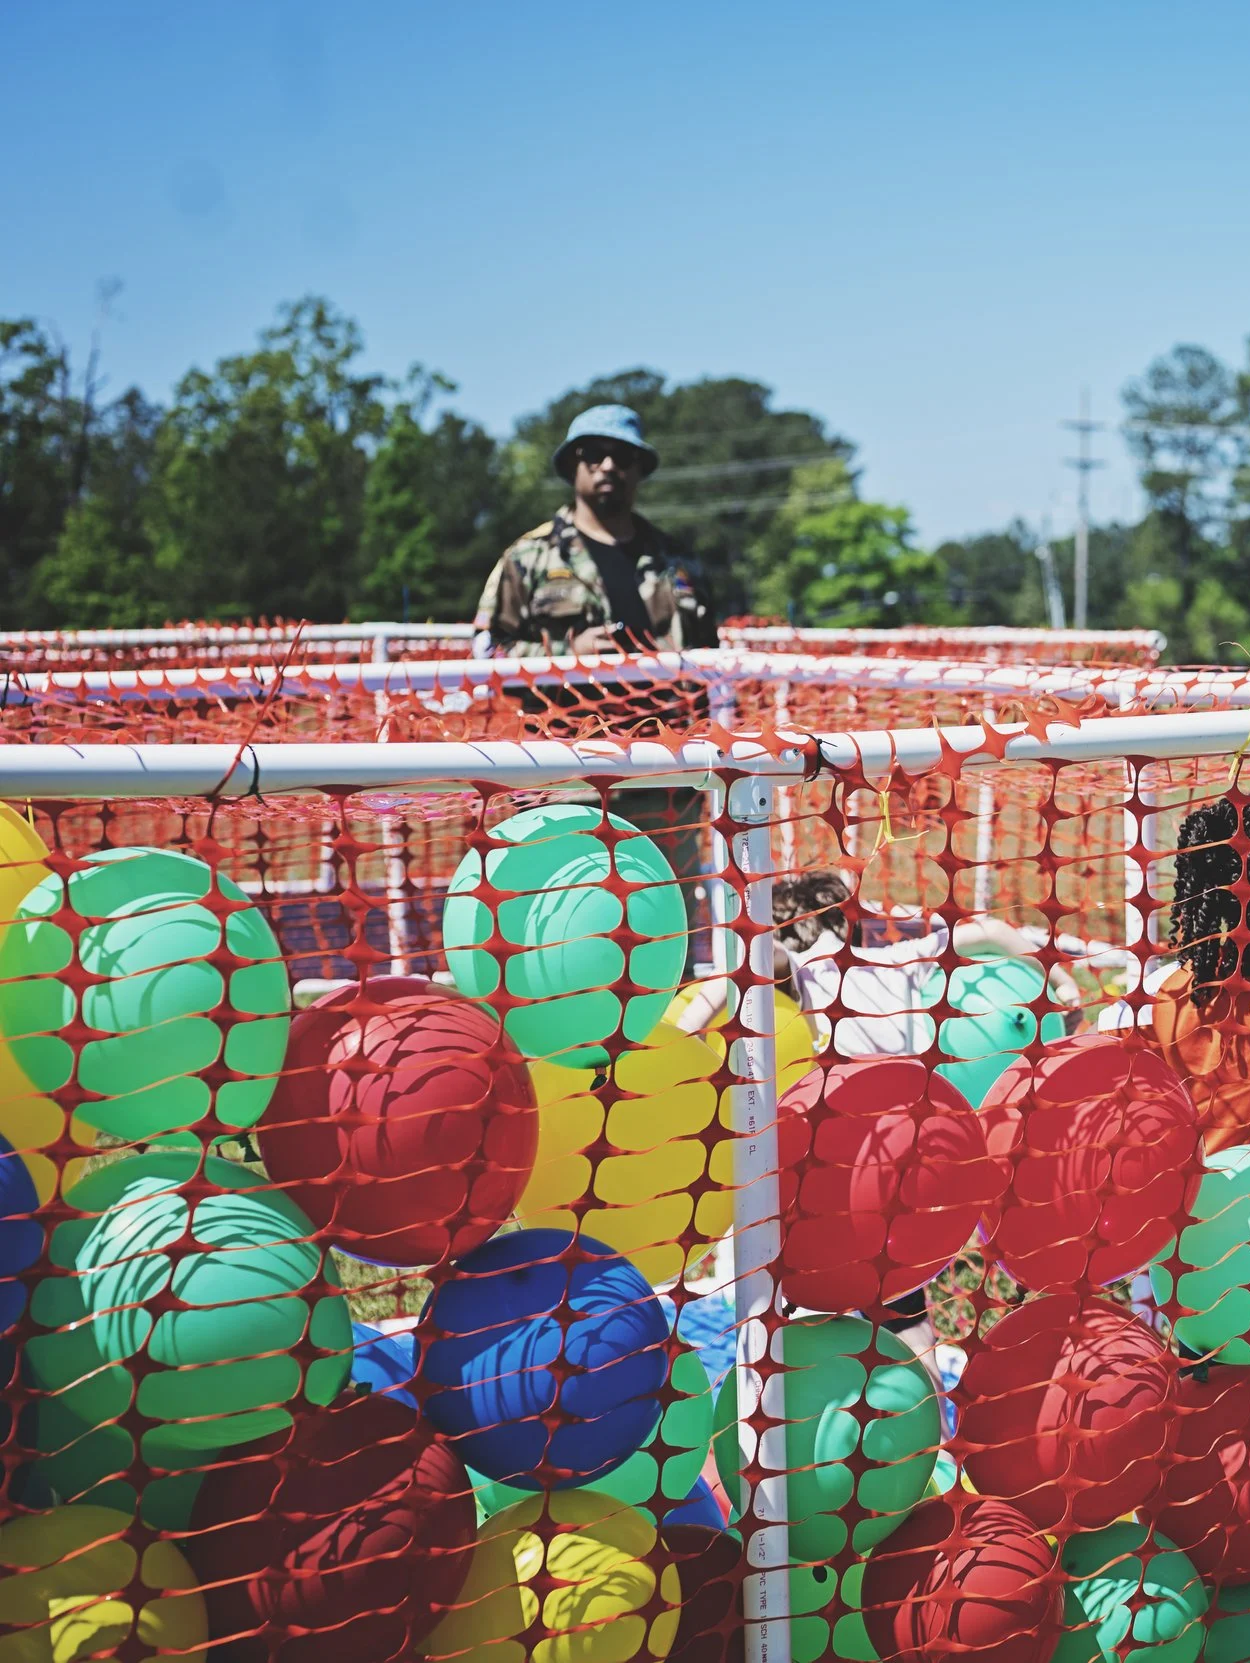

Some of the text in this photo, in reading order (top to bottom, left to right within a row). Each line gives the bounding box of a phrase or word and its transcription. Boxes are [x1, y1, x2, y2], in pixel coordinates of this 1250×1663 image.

[748, 1091, 756, 1111] EXT.
[749, 1145, 756, 1155] CL
[760, 1623, 768, 1640] SCH
